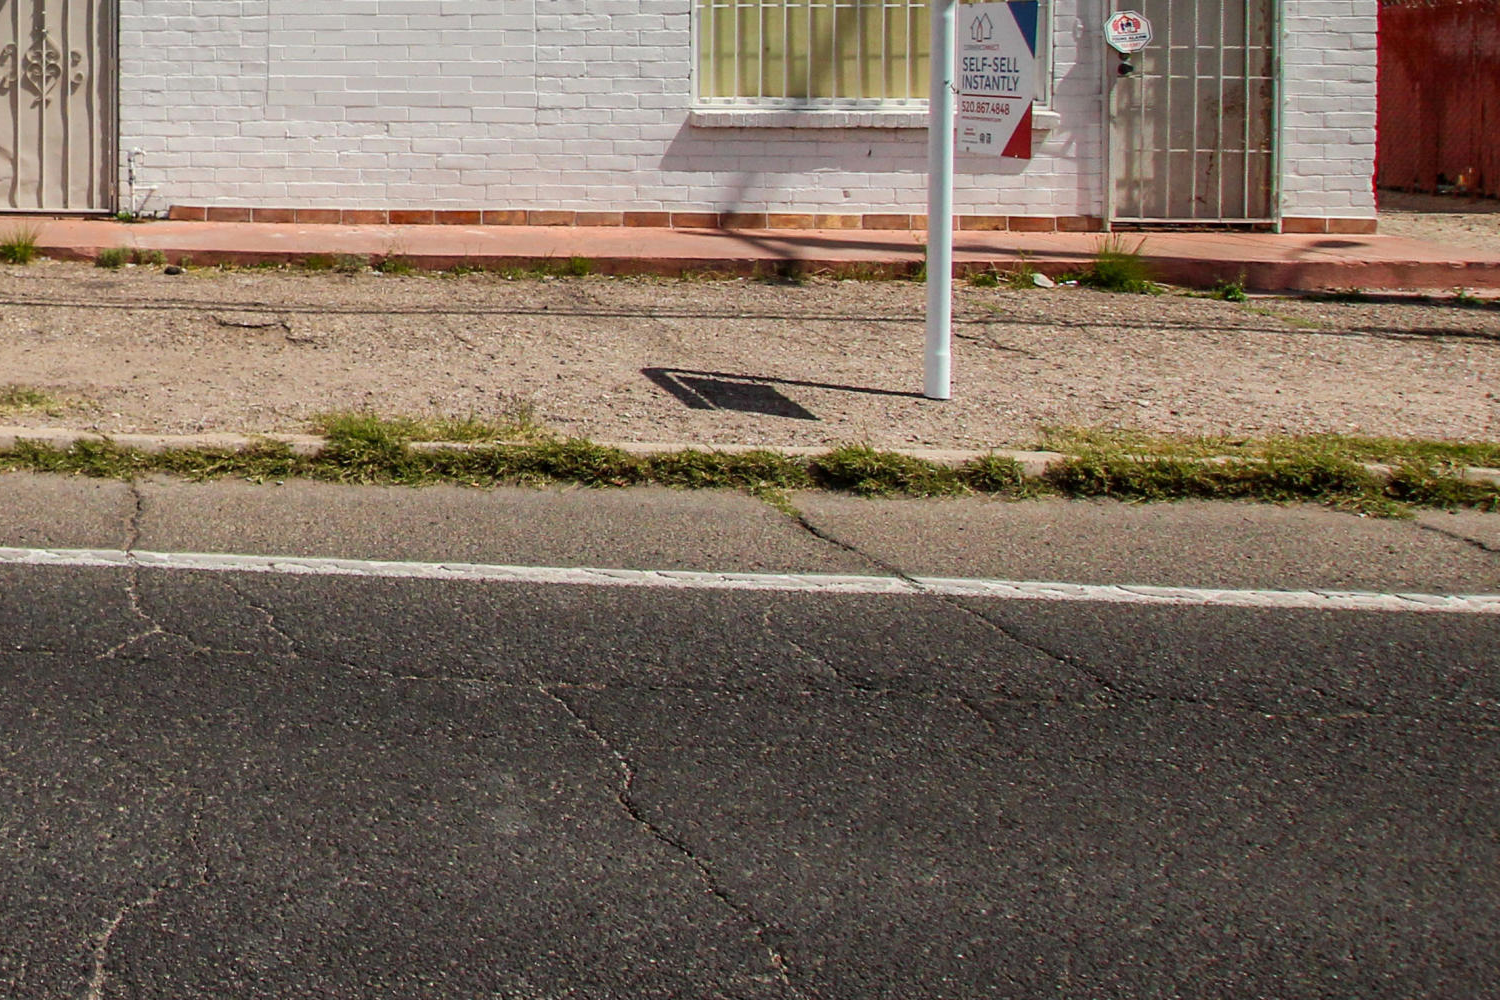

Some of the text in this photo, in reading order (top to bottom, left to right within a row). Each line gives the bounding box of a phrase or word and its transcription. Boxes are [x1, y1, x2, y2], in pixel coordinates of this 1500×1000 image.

[962, 56, 1020, 73] SELF-SELL
[961, 74, 1020, 92] INSTANTLY
[961, 100, 1010, 116] 520.867.4848
